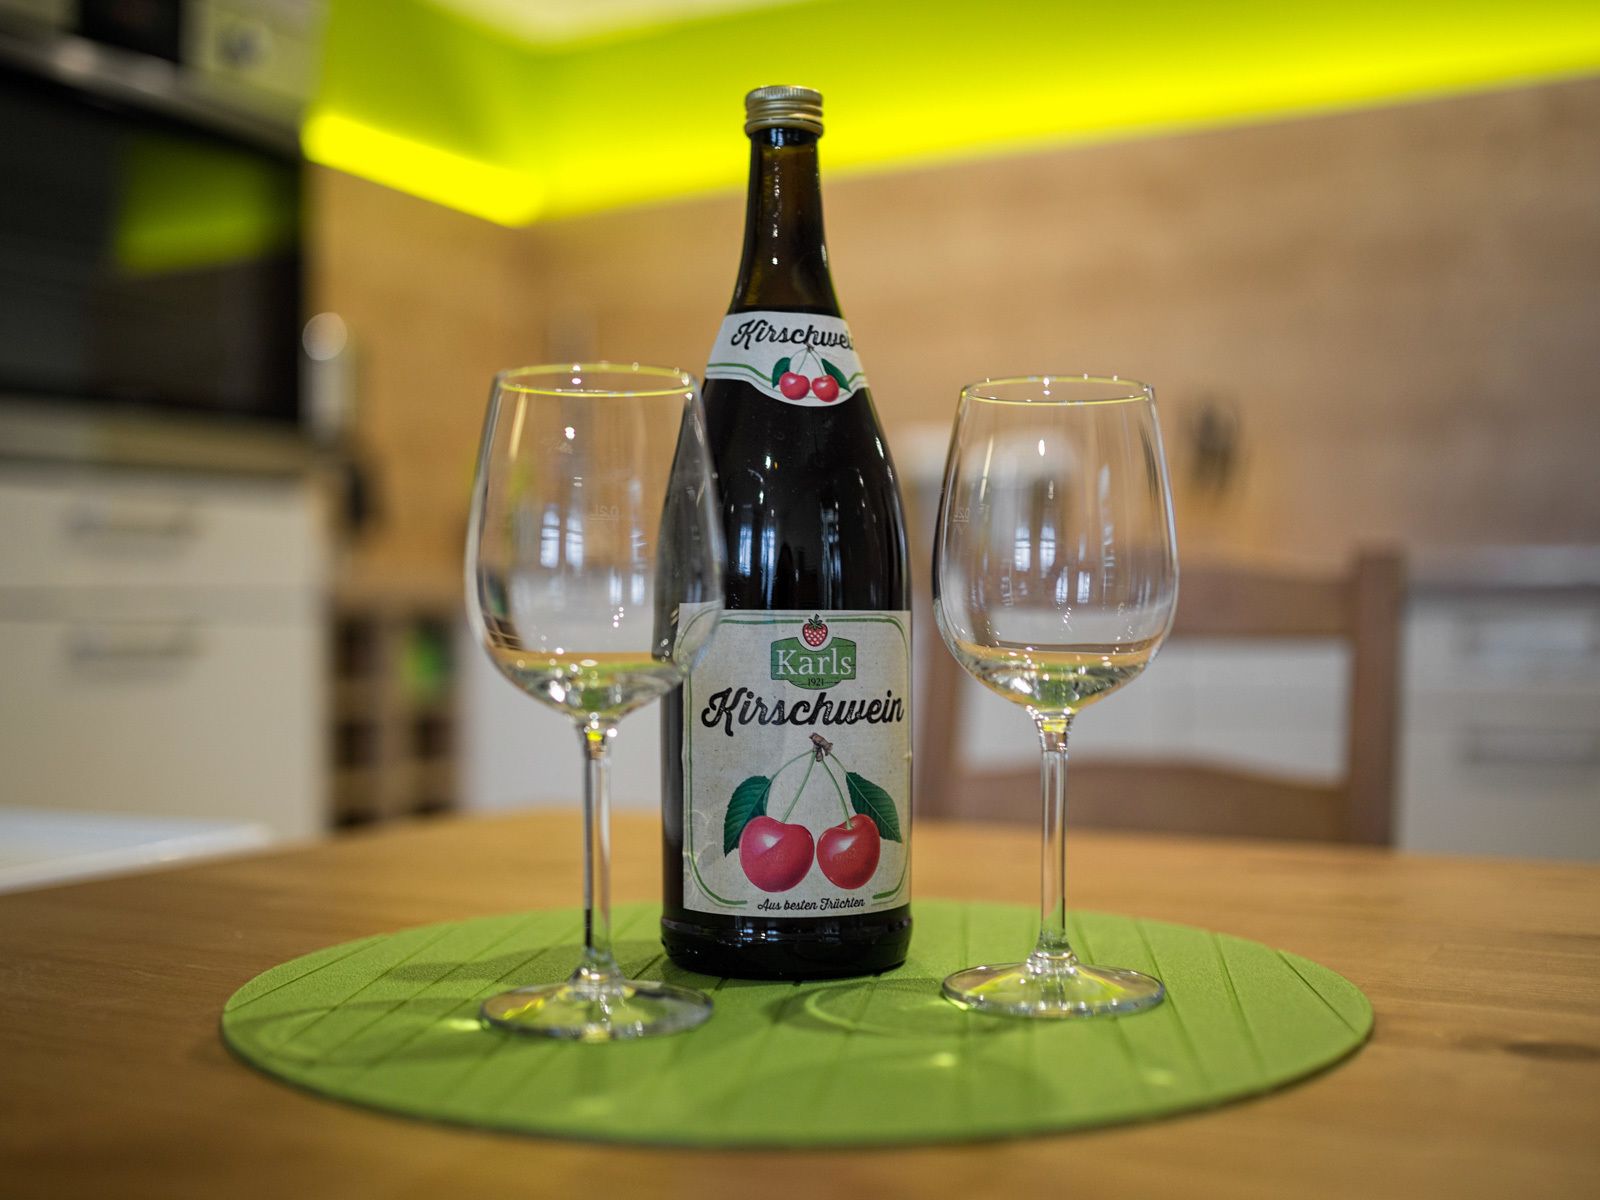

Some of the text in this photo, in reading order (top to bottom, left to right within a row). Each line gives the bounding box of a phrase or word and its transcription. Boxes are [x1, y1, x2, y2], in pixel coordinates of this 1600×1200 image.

[777, 648, 852, 676] Karls
[807, 677, 824, 686] 1921
[701, 687, 904, 737] Kirschwein
[757, 897, 865, 911] Aus besten Früchten
